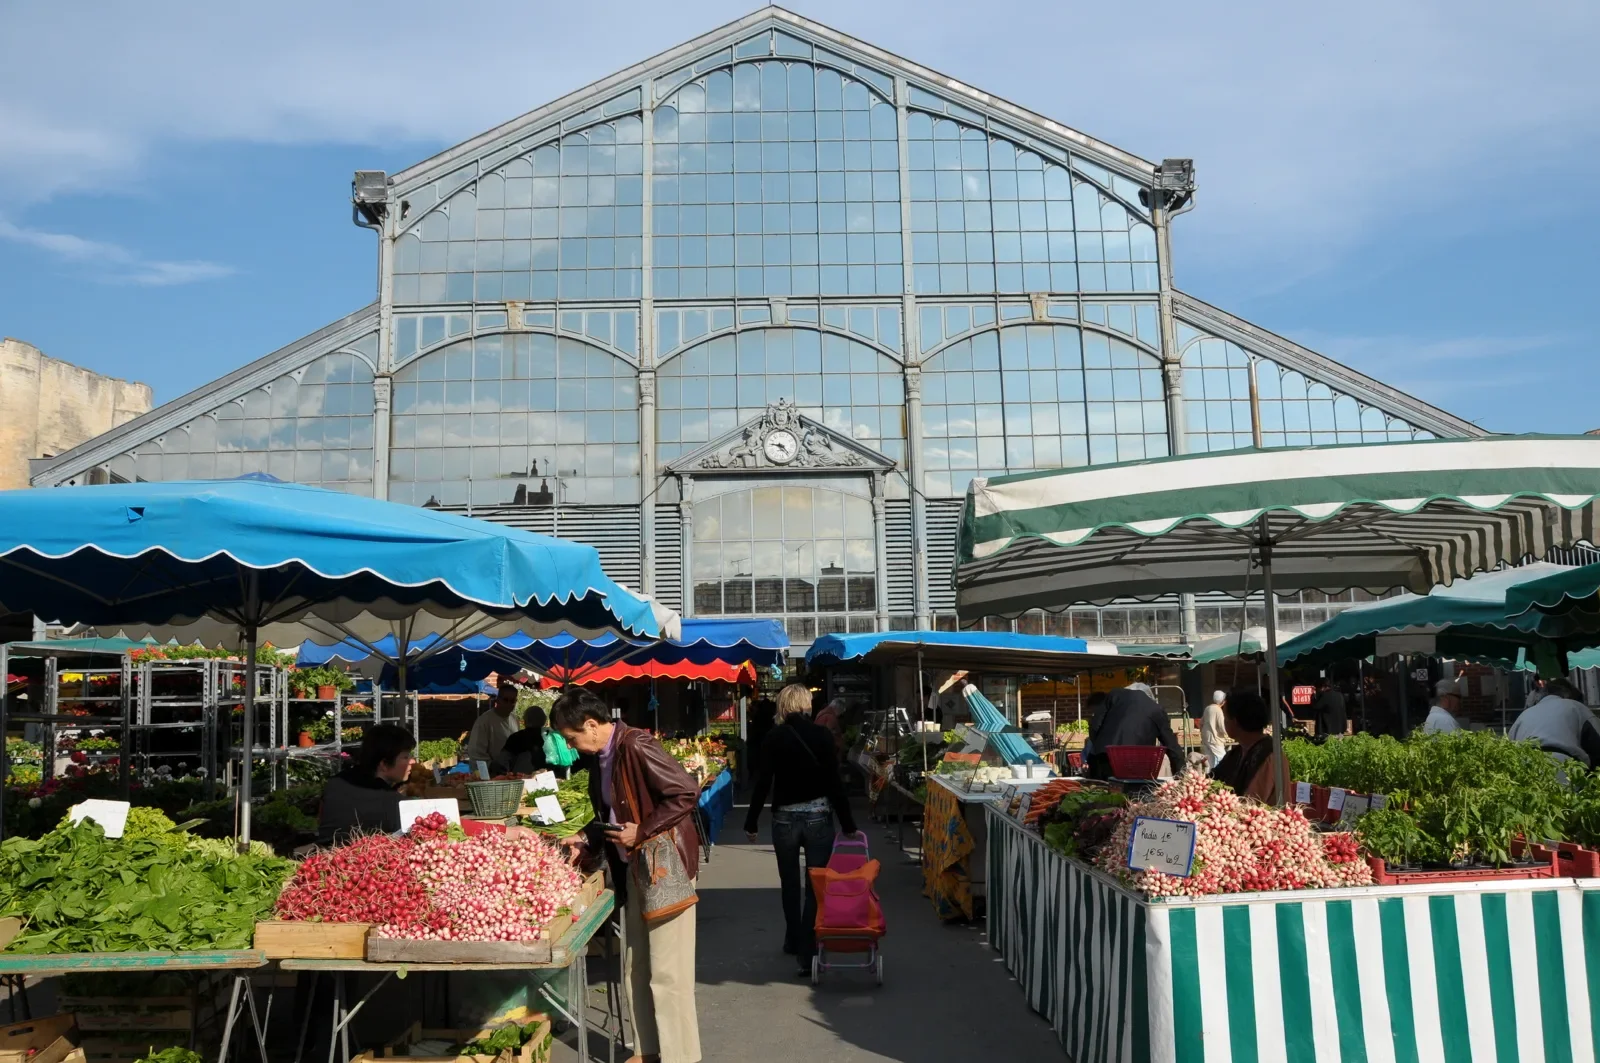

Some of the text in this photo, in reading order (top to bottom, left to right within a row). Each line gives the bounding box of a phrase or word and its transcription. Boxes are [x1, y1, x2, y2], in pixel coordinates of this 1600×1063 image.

[1293, 687, 1313, 695] OUVER
[1141, 828, 1172, 843] Radis 1€
[1173, 854, 1183, 867] 2
